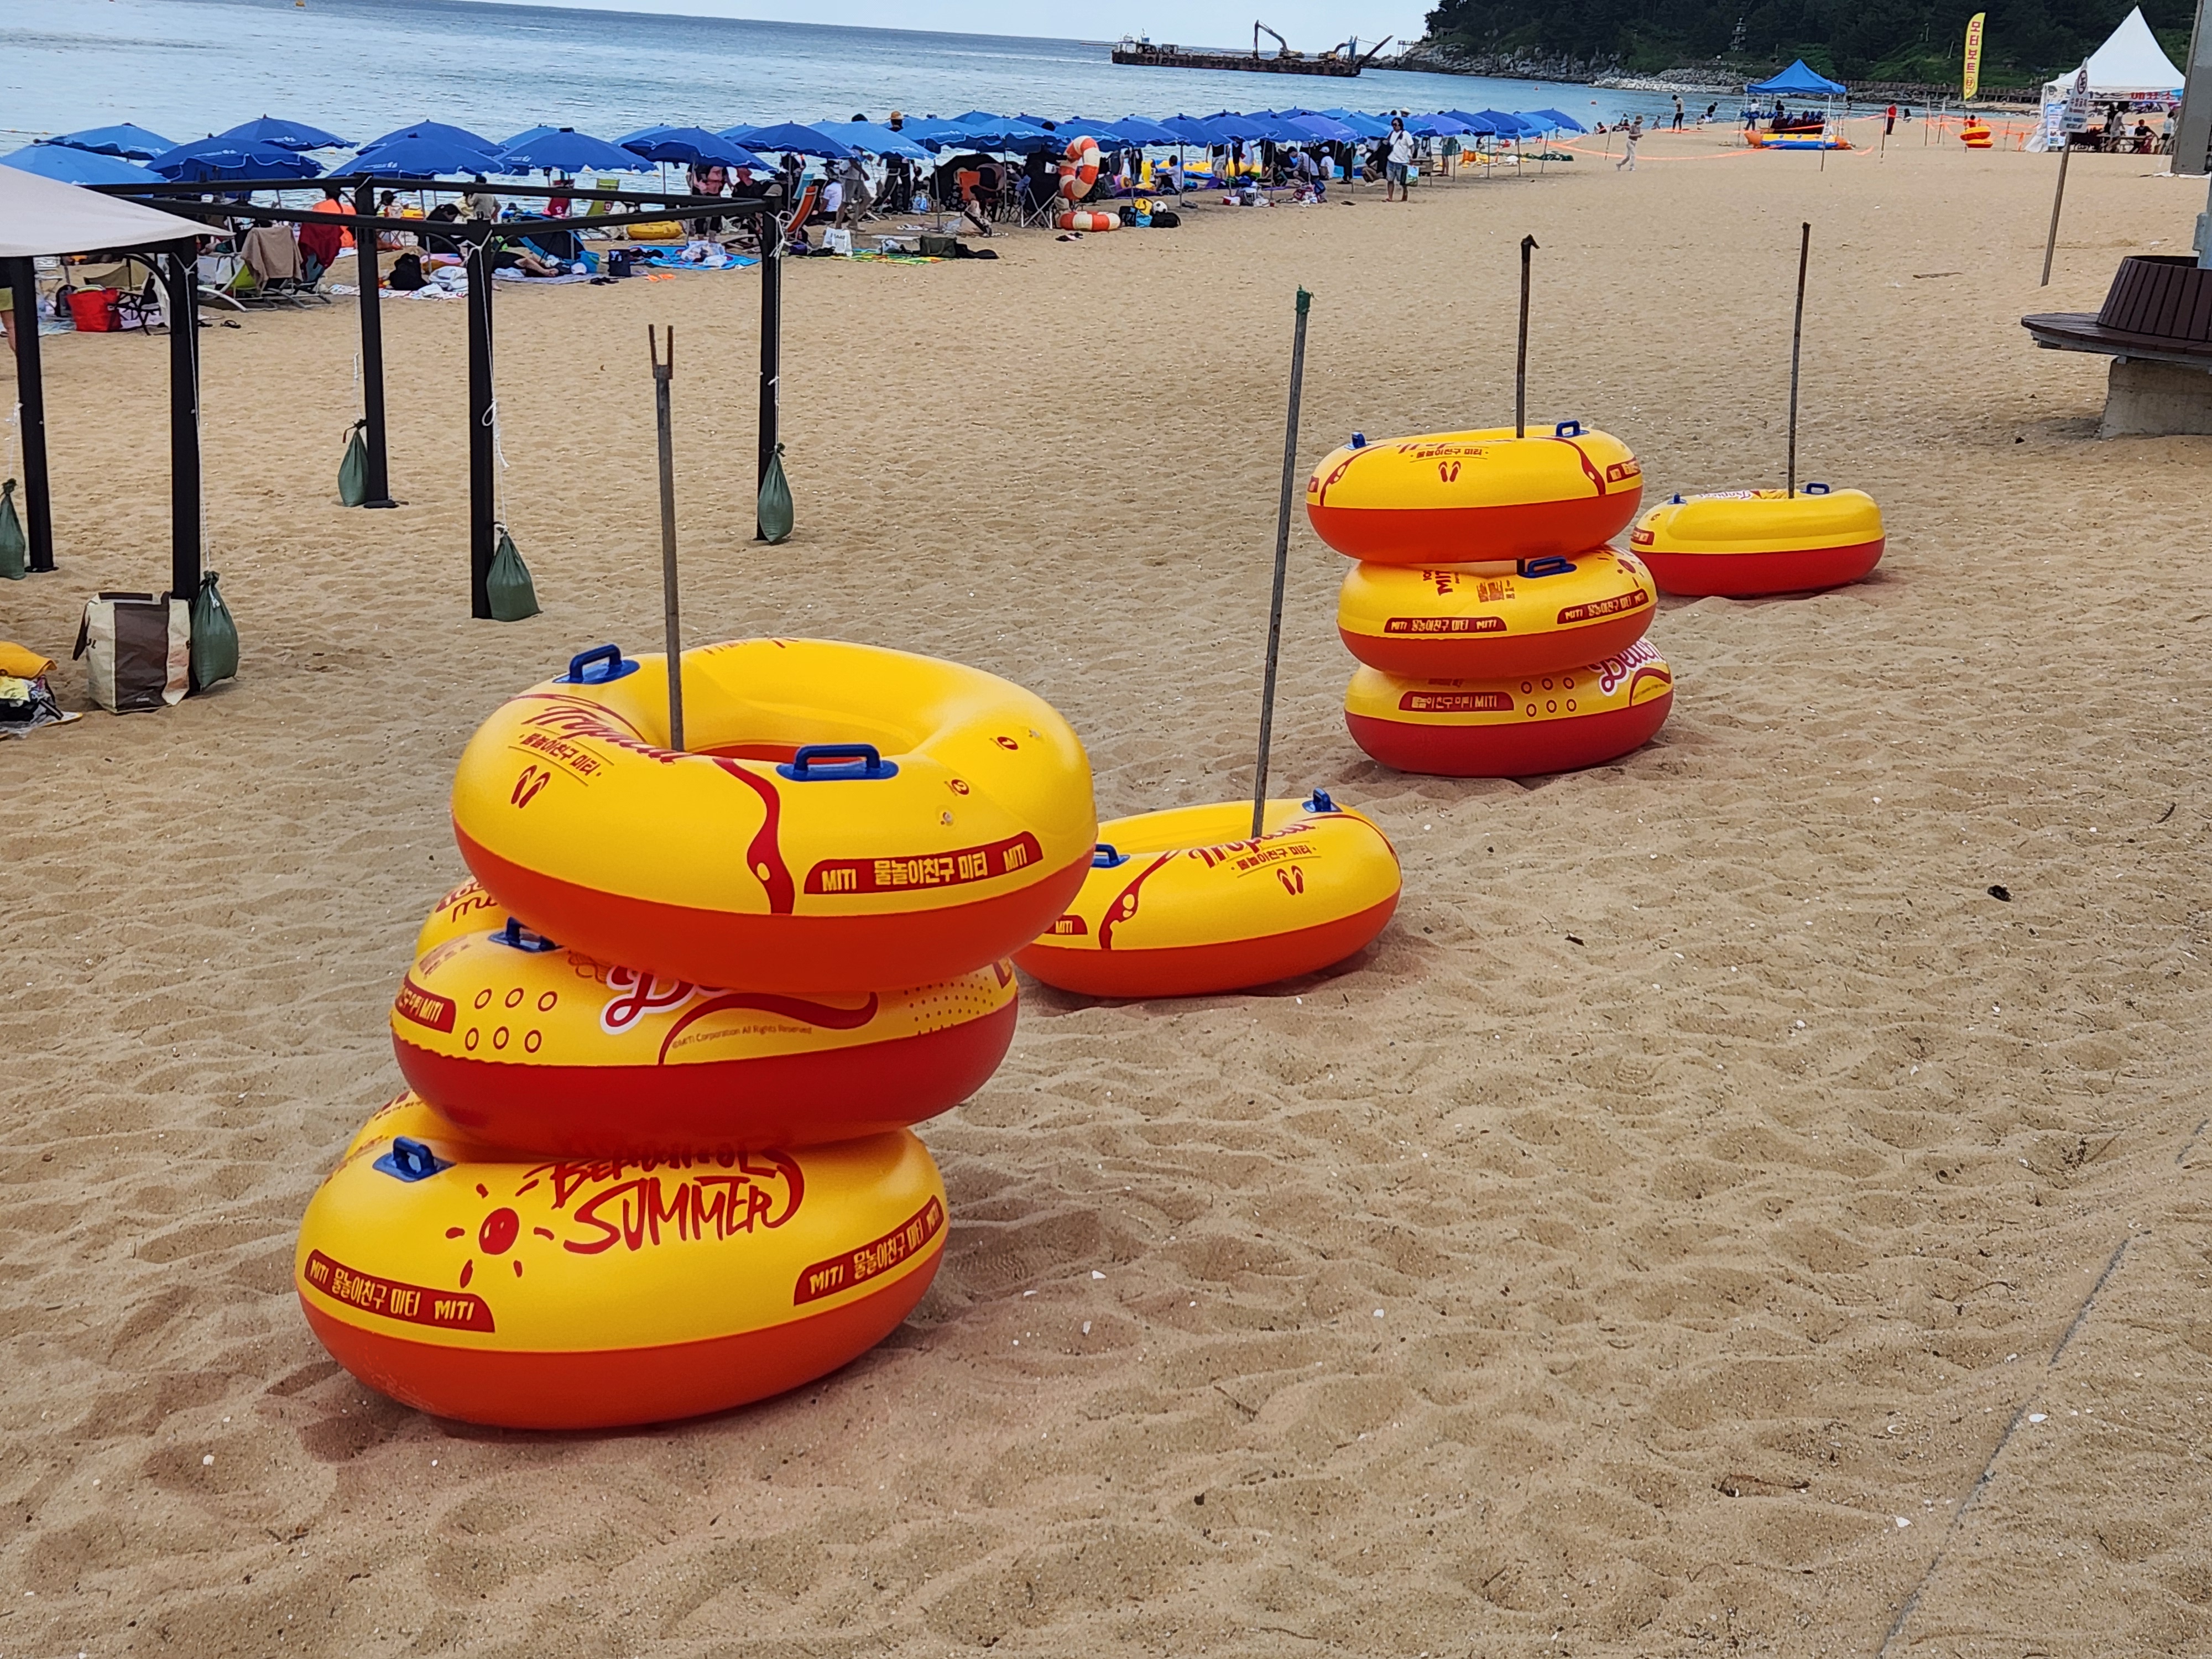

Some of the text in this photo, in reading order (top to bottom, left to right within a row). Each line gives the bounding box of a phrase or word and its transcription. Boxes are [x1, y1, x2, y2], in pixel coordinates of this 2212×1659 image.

[1966, 21, 1981, 74] 모터보트
[1391, 621, 1407, 630] MITI
[1476, 619, 1496, 630] MITI
[1564, 608, 1583, 620] MITI
[1474, 695, 1497, 708] MITI
[822, 843, 1027, 891] MITI 물놀이친구 미티 MITI
[1055, 920, 1073, 933] MITI
[419, 998, 445, 1023] MITI
[563, 1177, 805, 1254] SUMMER
[809, 1264, 844, 1295] MITI
[853, 1232, 905, 1280] 물놀이친구
[310, 1259, 474, 1321] MITI 물놀이친구 미티 MITI
